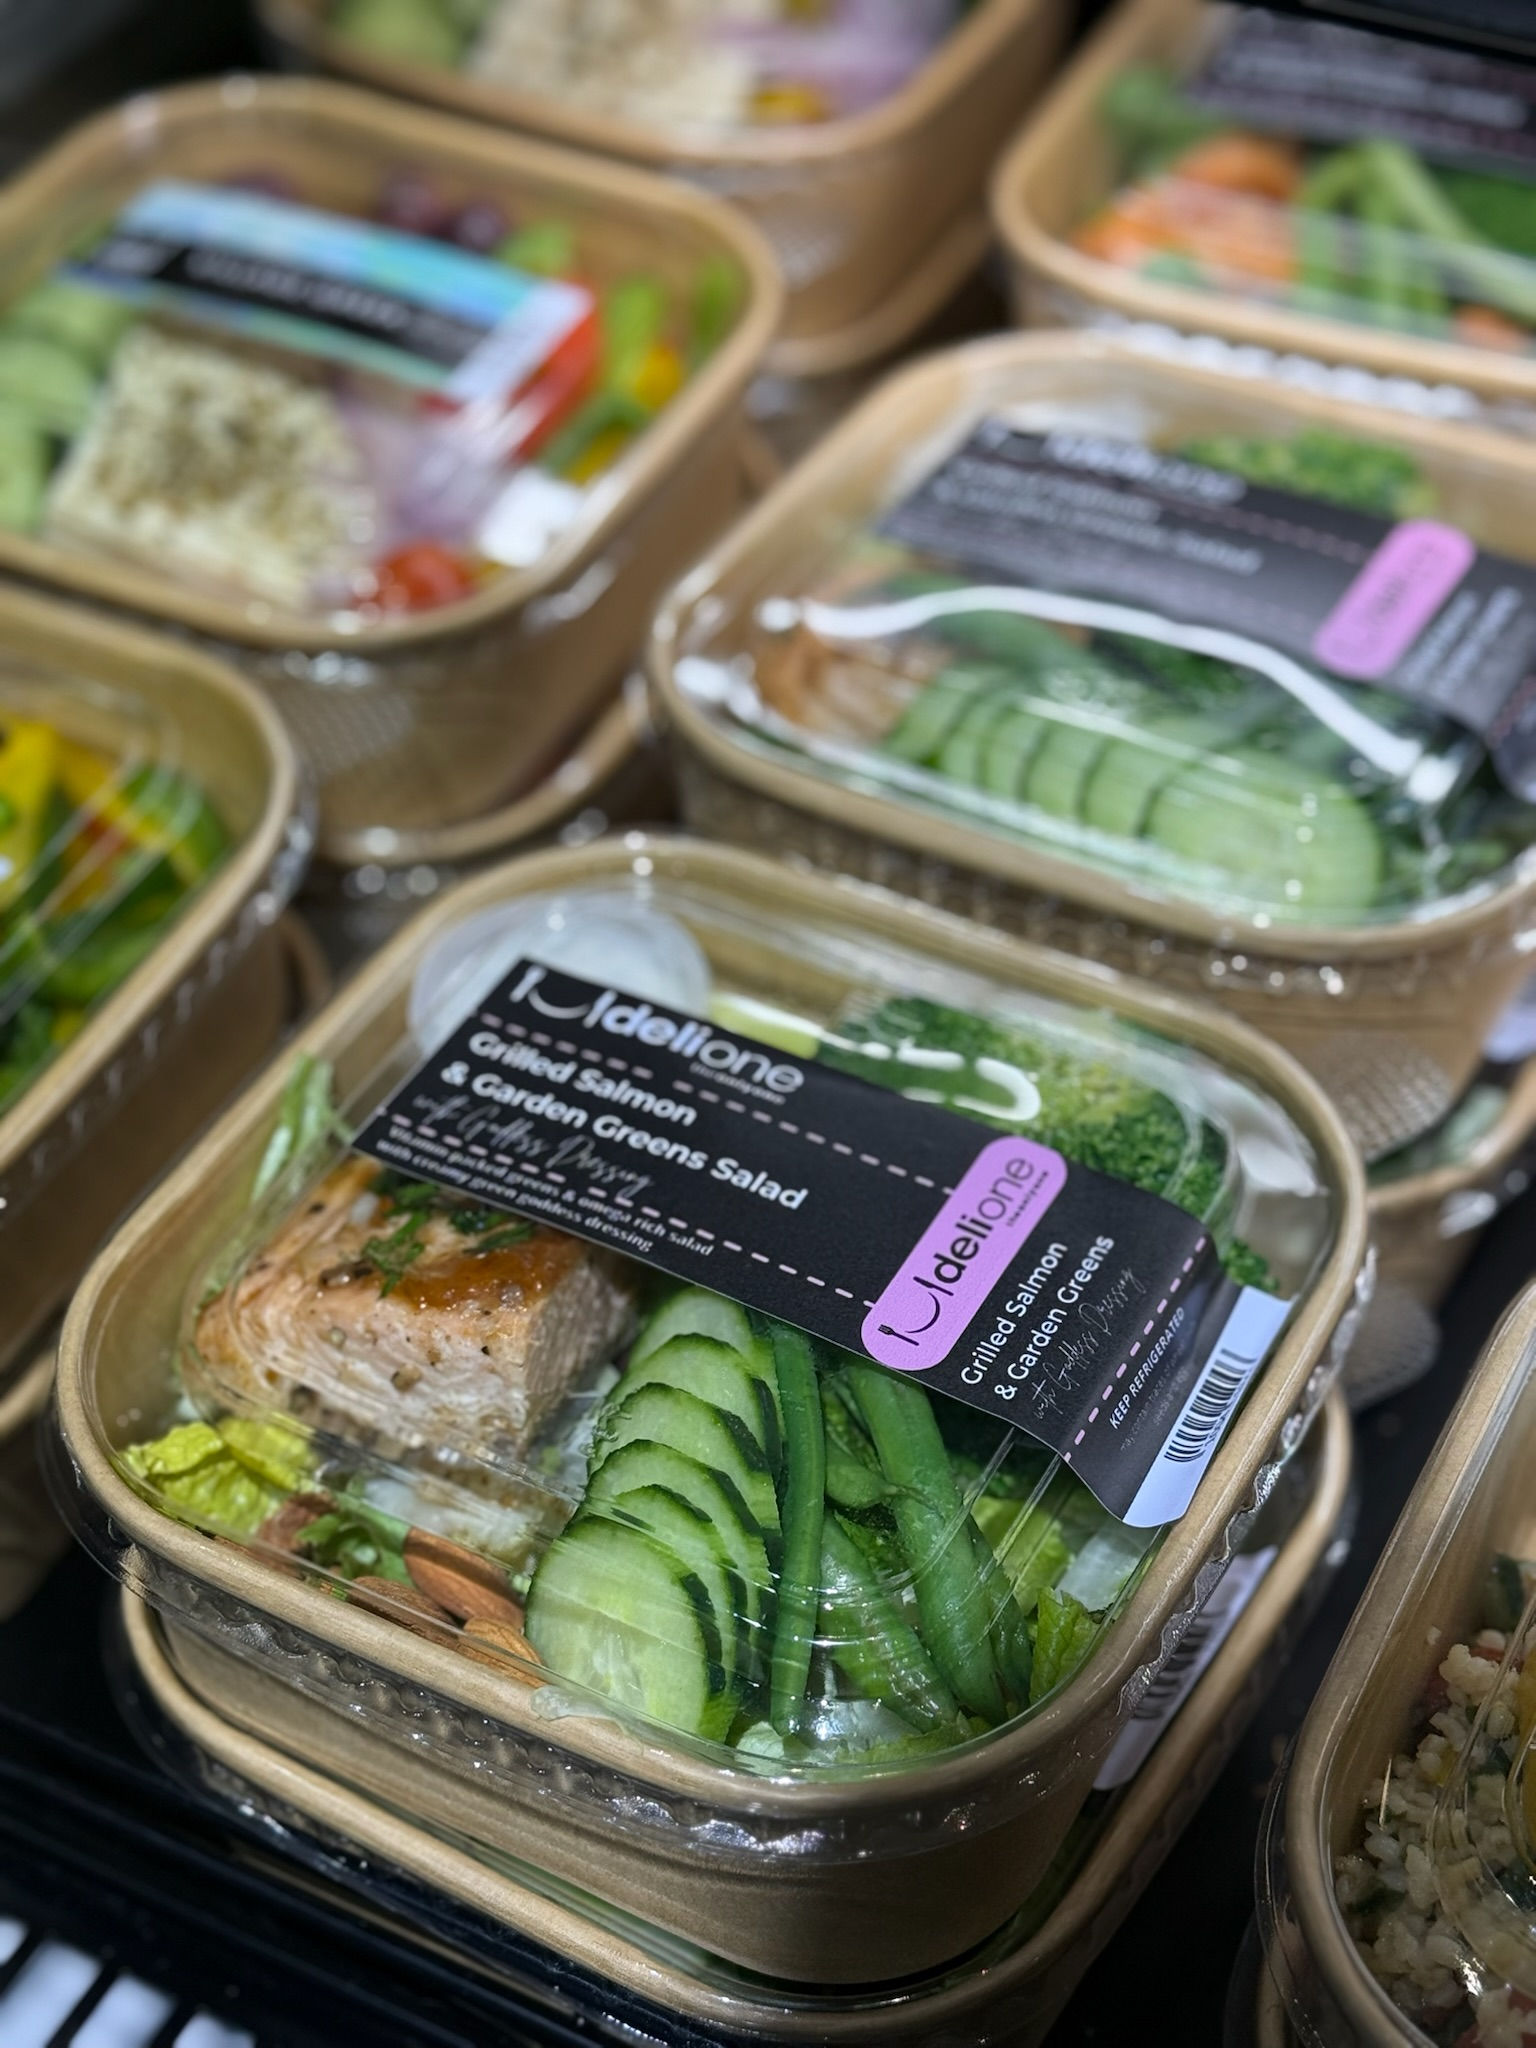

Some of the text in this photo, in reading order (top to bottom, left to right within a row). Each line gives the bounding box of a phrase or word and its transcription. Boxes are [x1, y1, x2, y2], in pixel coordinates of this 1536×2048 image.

[469, 1031, 697, 1127] Grilled Salmon
[601, 1003, 804, 1094] delione
[441, 1061, 809, 1210] & Garden Greens Salad
[502, 1171, 560, 1198] greens
[577, 1196, 632, 1224] omega
[633, 1216, 667, 1238] rich
[668, 1230, 714, 1257] salad
[515, 1192, 582, 1224] goddess
[584, 1215, 653, 1253] dressing
[933, 1157, 1034, 1285] delione
[960, 1241, 1069, 1385] Grilled Salmon
[994, 1235, 1115, 1401] & Garden Greens
[1078, 1265, 1147, 1336] Dressing
[1109, 1393, 1132, 1430] KEEP
[1129, 1305, 1185, 1399] REFRIGERATED
